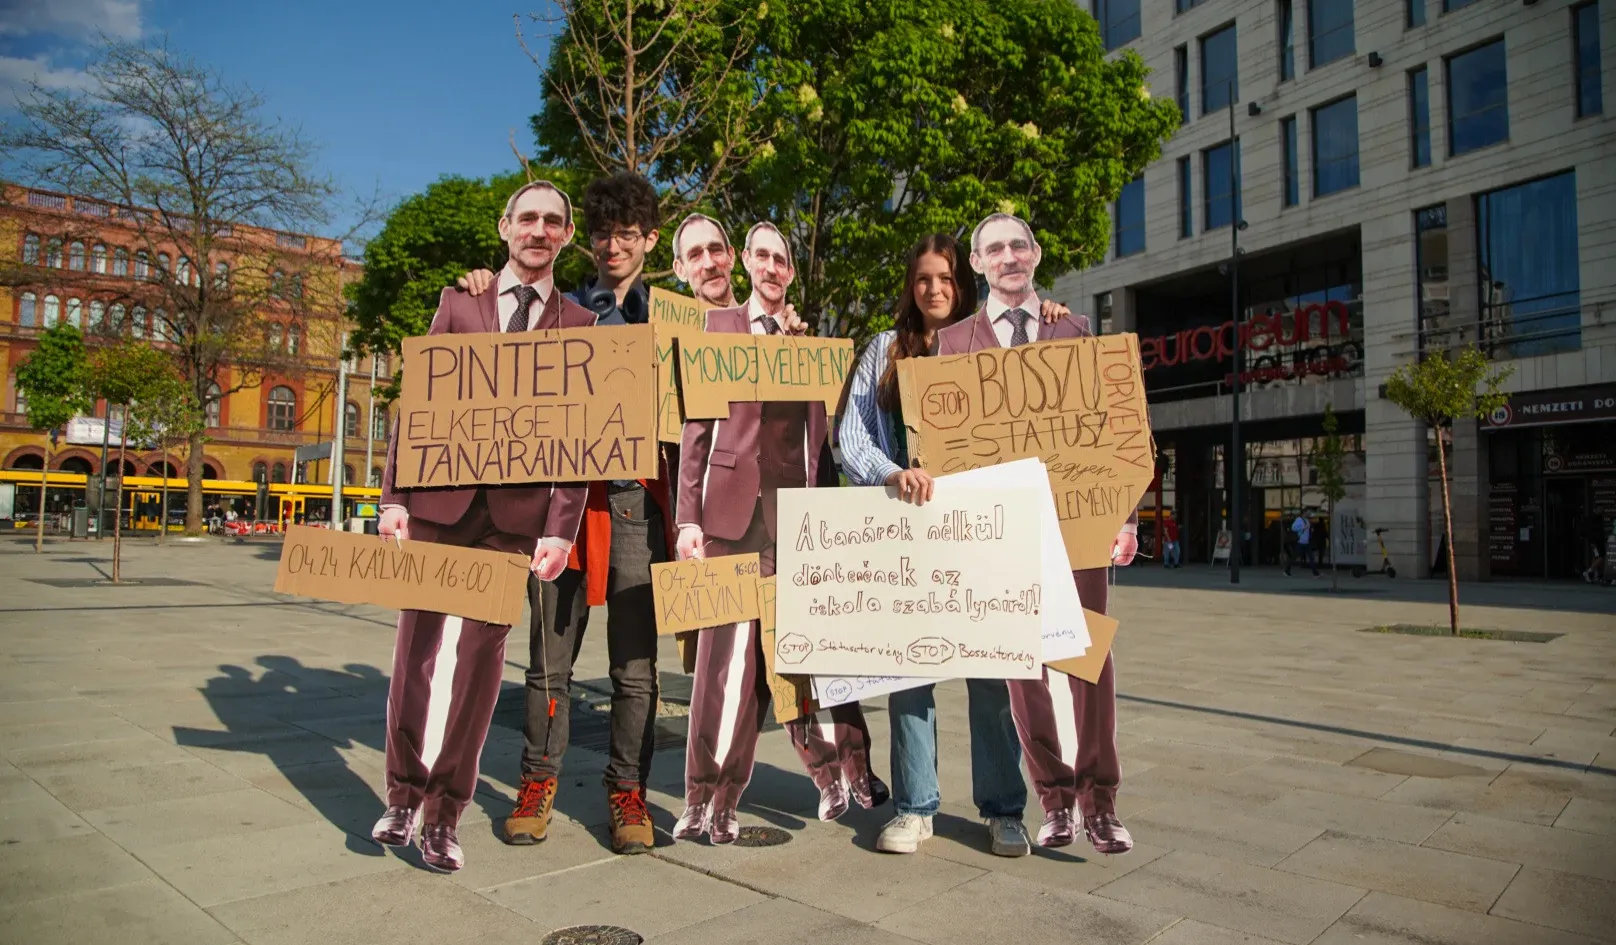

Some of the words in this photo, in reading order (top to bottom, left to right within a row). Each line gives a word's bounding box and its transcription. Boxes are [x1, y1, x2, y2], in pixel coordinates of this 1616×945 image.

[1140, 301, 1348, 369] europeum
[420, 330, 595, 401] PINTÉR
[927, 391, 966, 415] STOP
[1522, 401, 1583, 414] NEMZETI
[408, 403, 587, 441] ELKERGETI
[601, 403, 625, 436] A
[411, 436, 646, 483] TANÁRAINKAT
[796, 512, 814, 551] A
[820, 516, 913, 549] tanárok
[928, 504, 1004, 541] nélkül
[349, 547, 426, 585] KÁLVIN
[435, 557, 494, 593] 16:00
[734, 563, 759, 577] 16:00
[931, 570, 961, 586] az
[662, 583, 745, 625] KÁLVIN
[809, 591, 882, 616] iskola
[781, 643, 810, 654] STOP
[910, 644, 949, 658] STOP
[830, 685, 848, 697] STOP
